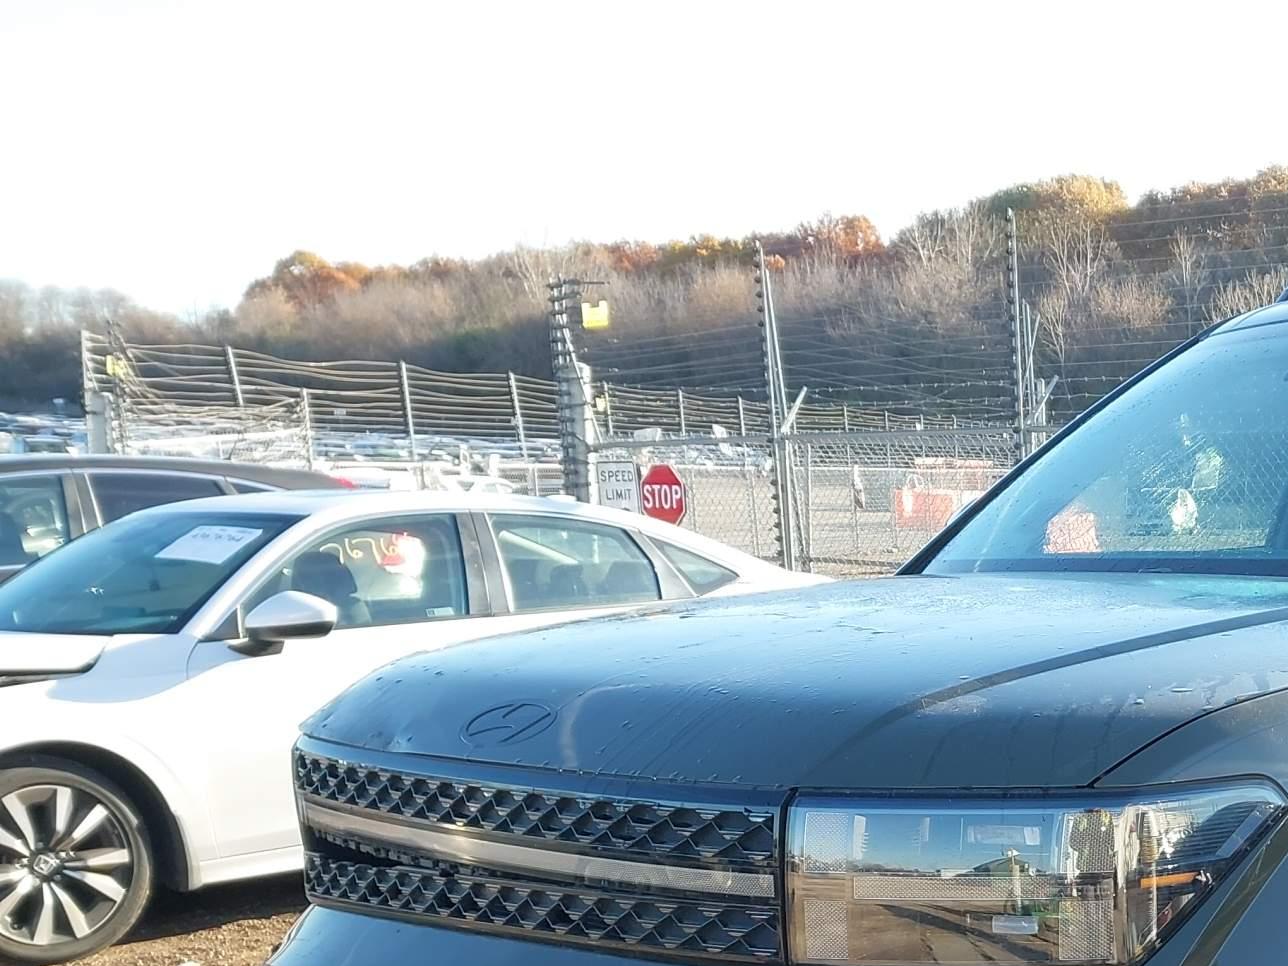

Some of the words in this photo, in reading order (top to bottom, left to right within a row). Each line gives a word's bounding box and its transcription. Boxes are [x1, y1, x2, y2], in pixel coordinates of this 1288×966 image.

[600, 469, 634, 482] SPEED
[605, 489, 633, 502] LIMIT
[643, 484, 682, 510] STOP
